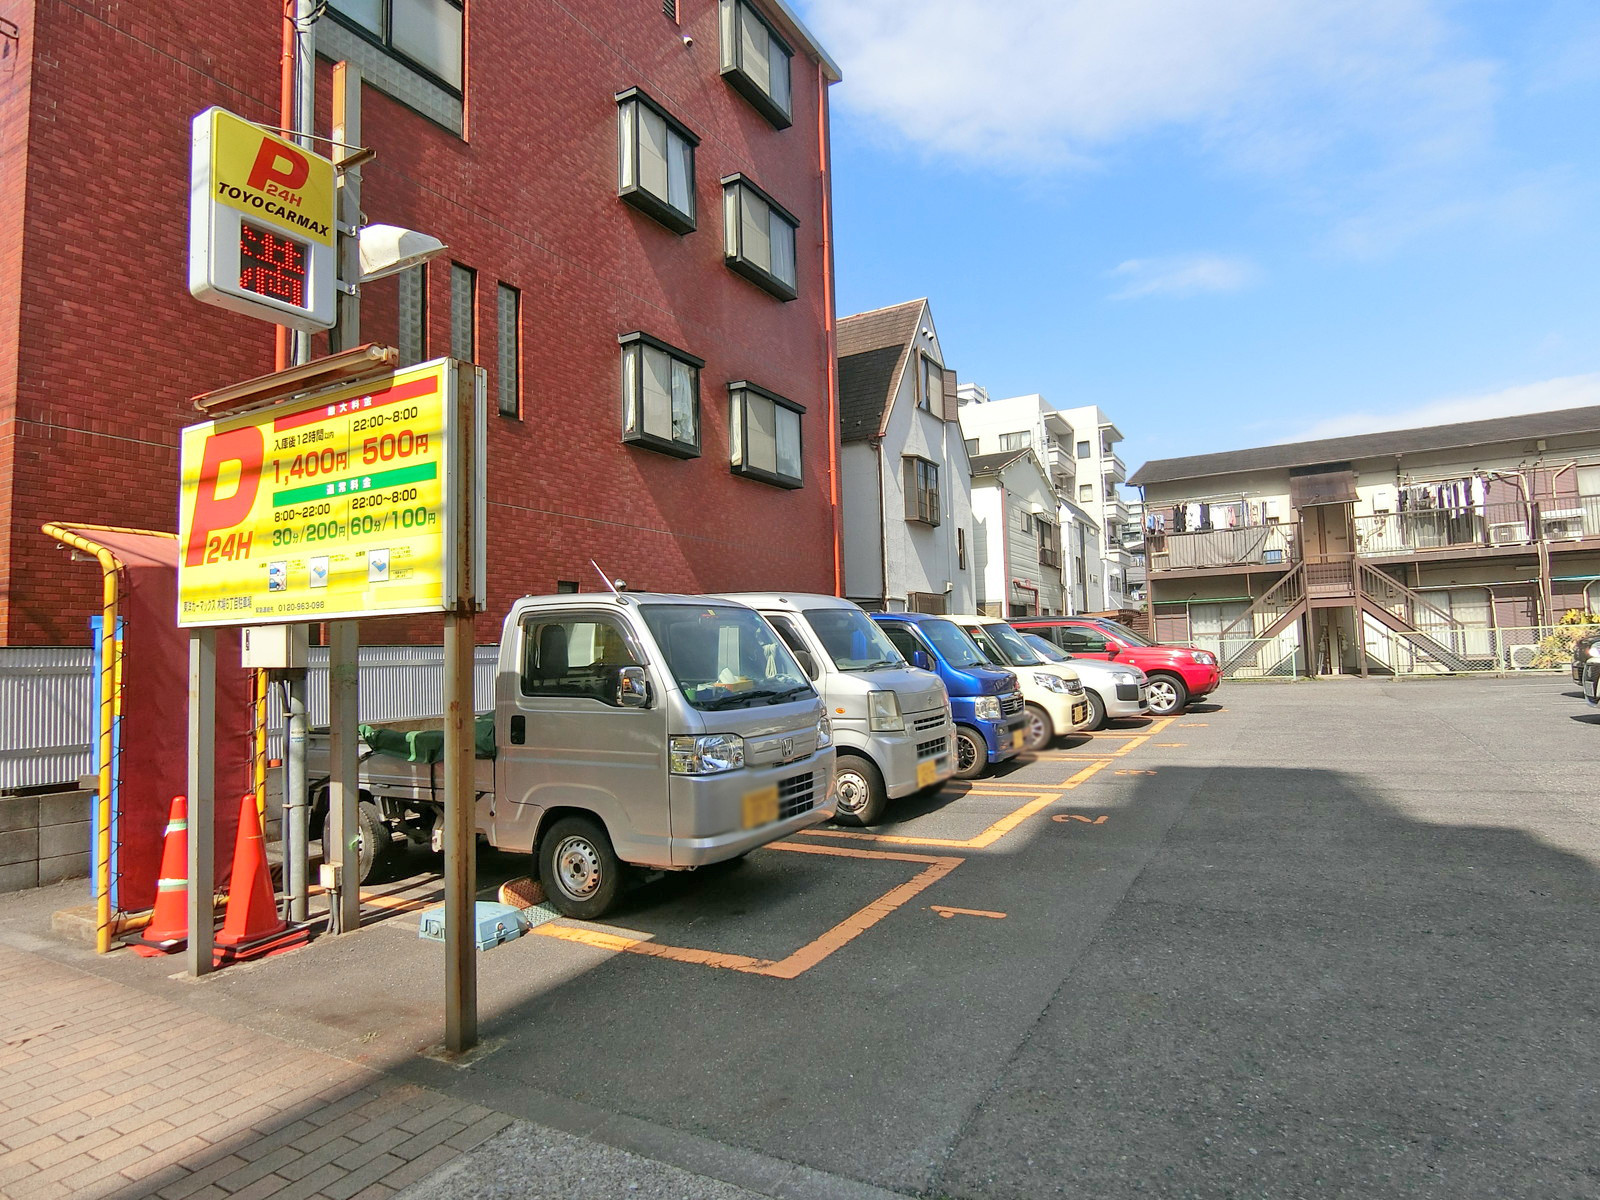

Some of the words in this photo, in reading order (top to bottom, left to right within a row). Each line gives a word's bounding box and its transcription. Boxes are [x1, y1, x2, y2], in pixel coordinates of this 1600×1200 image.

[247, 137, 310, 191] P
[218, 182, 330, 236] TOYOCARMAX
[266, 184, 302, 207] 24H
[327, 396, 372, 416] 最大料金
[363, 429, 428, 465] 500円
[273, 448, 347, 485] 1,400円
[185, 425, 264, 567] P
[326, 477, 372, 495] 通常料金
[273, 520, 345, 546] 30分/200円
[351, 507, 436, 535] 60分/100円
[207, 531, 253, 564] 24H
[278, 601, 324, 611] 0120-963-098
